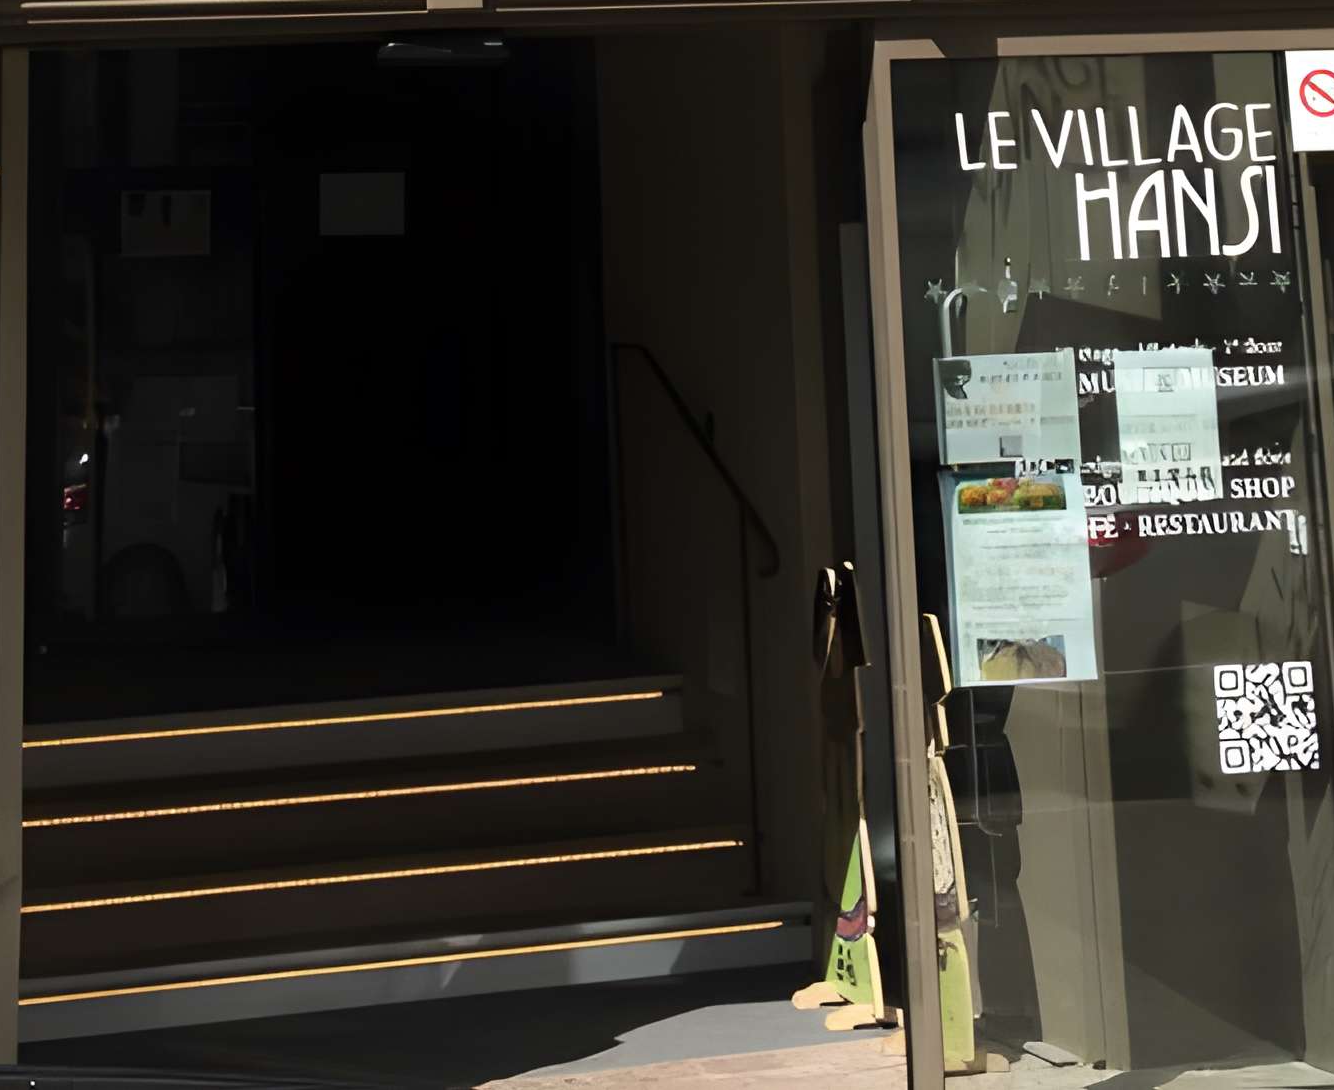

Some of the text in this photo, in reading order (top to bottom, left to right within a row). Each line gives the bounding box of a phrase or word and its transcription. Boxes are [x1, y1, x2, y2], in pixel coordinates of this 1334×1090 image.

[955, 102, 1276, 171] LE VILLAGE
[1075, 165, 1281, 261] HANSI
[1230, 475, 1296, 499] SHOP
[1138, 509, 1295, 538] RESTAURANT
